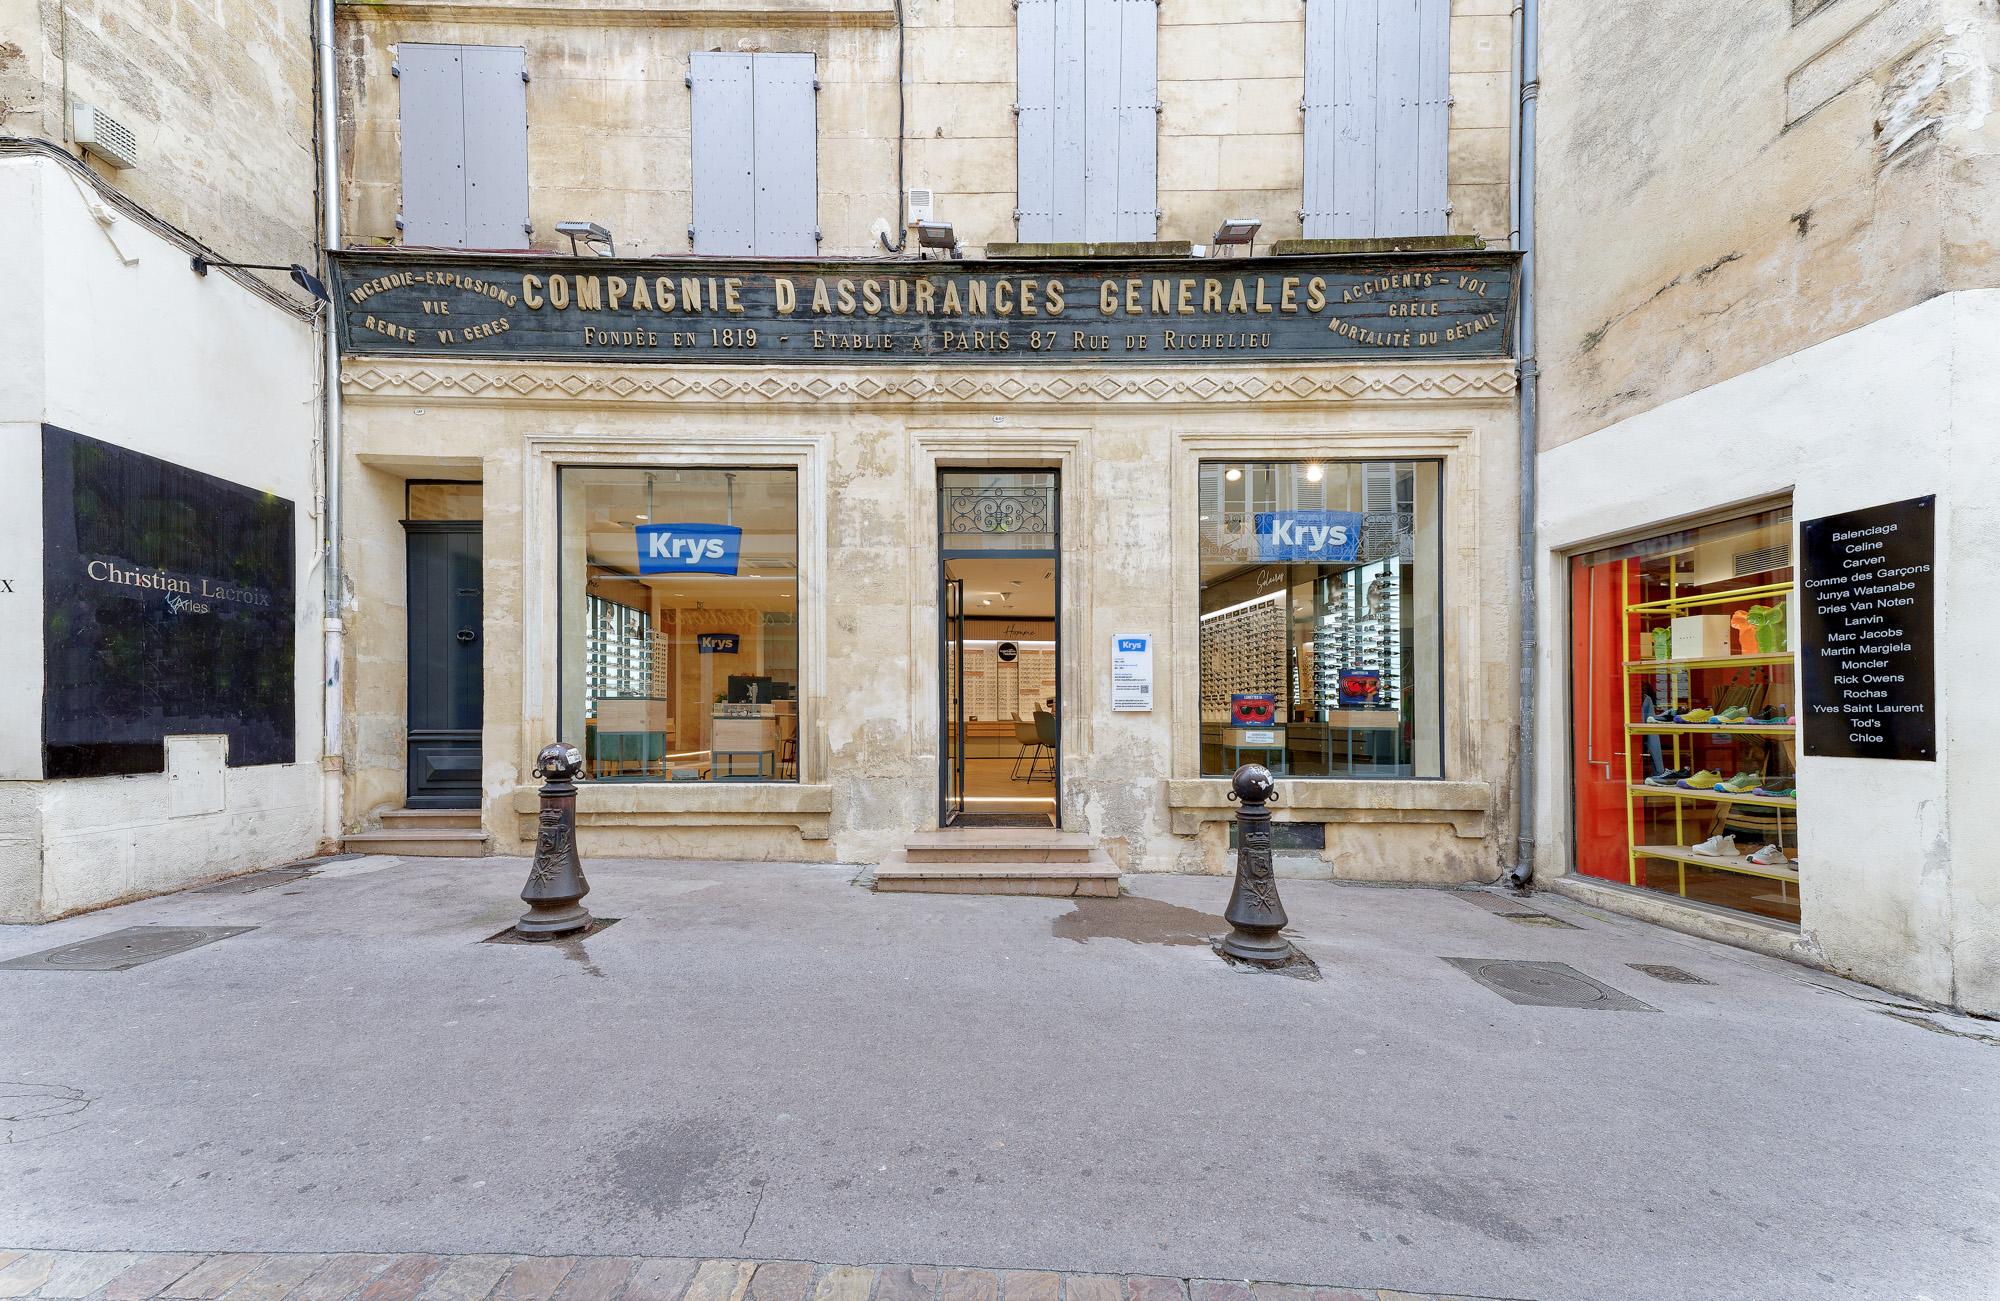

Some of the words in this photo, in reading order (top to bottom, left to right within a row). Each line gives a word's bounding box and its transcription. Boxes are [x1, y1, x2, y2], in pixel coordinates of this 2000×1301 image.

[522, 273, 745, 313] COMPAGNIE
[811, 278, 1065, 316] ASSURANCES
[1099, 276, 1327, 316] GENERALES
[1342, 273, 1433, 303] ACCIDENTS
[1459, 275, 1488, 297] VOL
[422, 301, 450, 315] VIE
[365, 315, 416, 344] RENTE
[673, 332, 696, 346] EN
[712, 328, 757, 347] 1819
[943, 331, 1010, 350] PARIS
[1030, 331, 1057, 349] 87
[1073, 330, 1110, 350] RUE
[1126, 335, 1147, 349] DE
[1164, 330, 1271, 349] RICHELIEU
[1419, 332, 1438, 346] DU
[1271, 519, 1348, 551] Krys
[1832, 523, 1898, 542] Balenciaga
[649, 532, 725, 564] Krys
[1845, 541, 1884, 554] Celine
[1843, 555, 1886, 569] Carven
[87, 560, 192, 594] Christian
[201, 578, 270, 607] Lacroix
[1805, 576, 1848, 589] Comme
[1851, 571, 1873, 583] des
[1876, 564, 1930, 578] Garçons
[1816, 589, 1850, 602] Junya
[1853, 581, 1916, 596] Watanabe
[1818, 605, 1847, 615] Dries
[1850, 601, 1873, 611] Van
[1877, 597, 1914, 609] Noten
[1845, 615, 1884, 627] Lanvin
[1828, 632, 1857, 642] Marc
[1860, 628, 1904, 640] Jacobs
[702, 637, 733, 650] Krys
[1122, 641, 1142, 650] Krys
[1821, 646, 1856, 657] Martin
[1859, 642, 1912, 655] Margiela
[1841, 659, 1889, 670] Moncler
[1834, 674, 1859, 684] Rick
[1862, 674, 1905, 683] Owens
[1843, 689, 1888, 698] Rochas
[1812, 704, 1840, 713] Yves
[1843, 704, 1873, 713] Saint
[1876, 703, 1924, 713] Laurent
[1850, 718, 1882, 728] Tod's
[1849, 733, 1884, 743] Chloe
